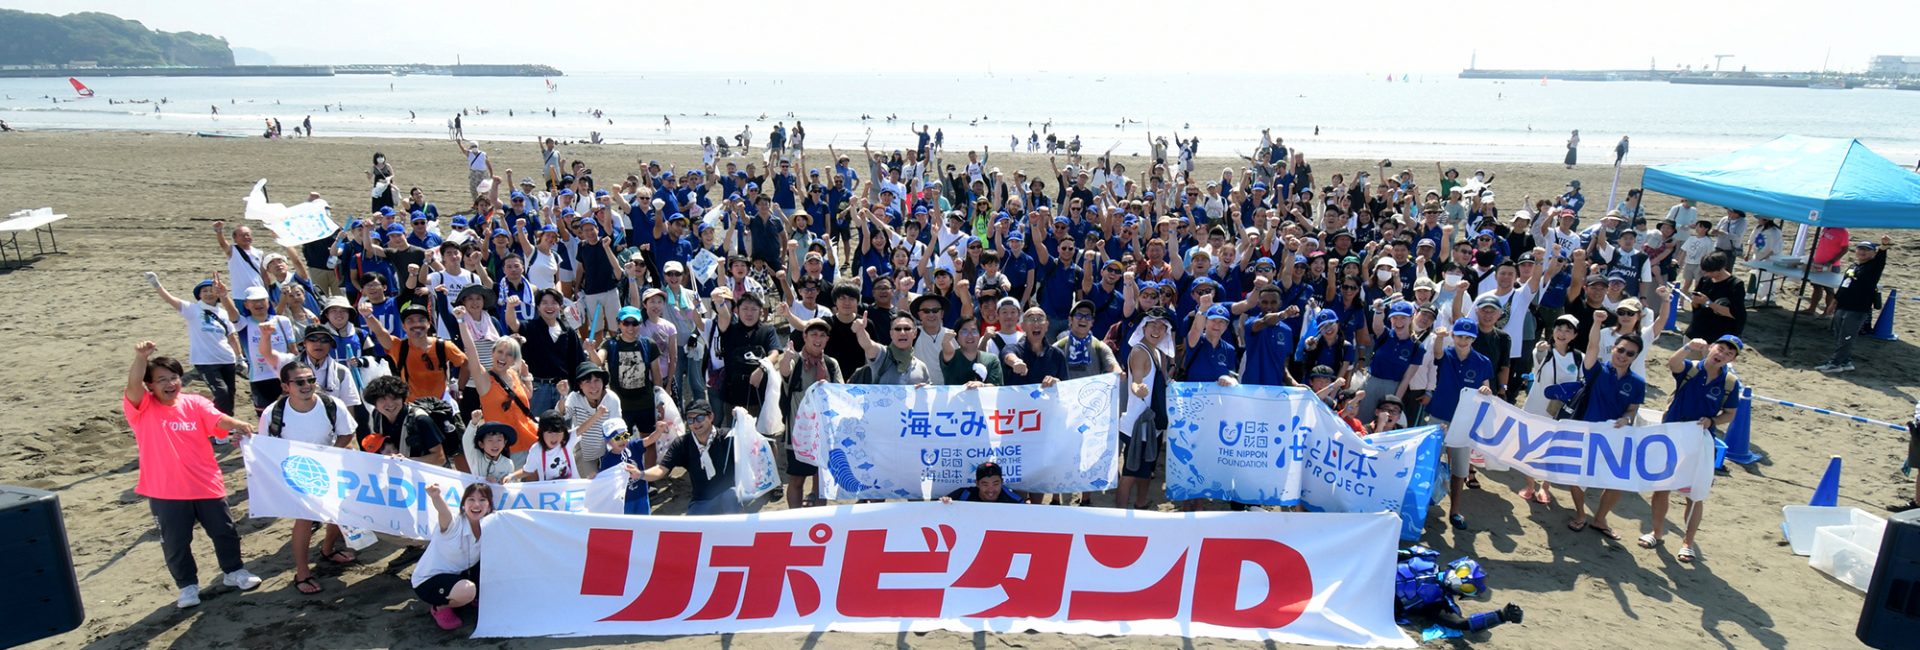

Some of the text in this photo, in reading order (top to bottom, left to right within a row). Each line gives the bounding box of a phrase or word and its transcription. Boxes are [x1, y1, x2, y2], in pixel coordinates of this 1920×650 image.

[900, 408, 1042, 438] 海ごみゼロ
[1245, 421, 1268, 433] 日本
[966, 445, 1022, 458] CHANGE
[1219, 447, 1268, 459] THE NIPPON
[1469, 401, 1678, 481] UYENO
[1217, 457, 1268, 468] FOUNDATION
[337, 470, 586, 513] PADI AARE
[1305, 459, 1375, 497] PROJECT
[580, 523, 1314, 630] リポビタンD
